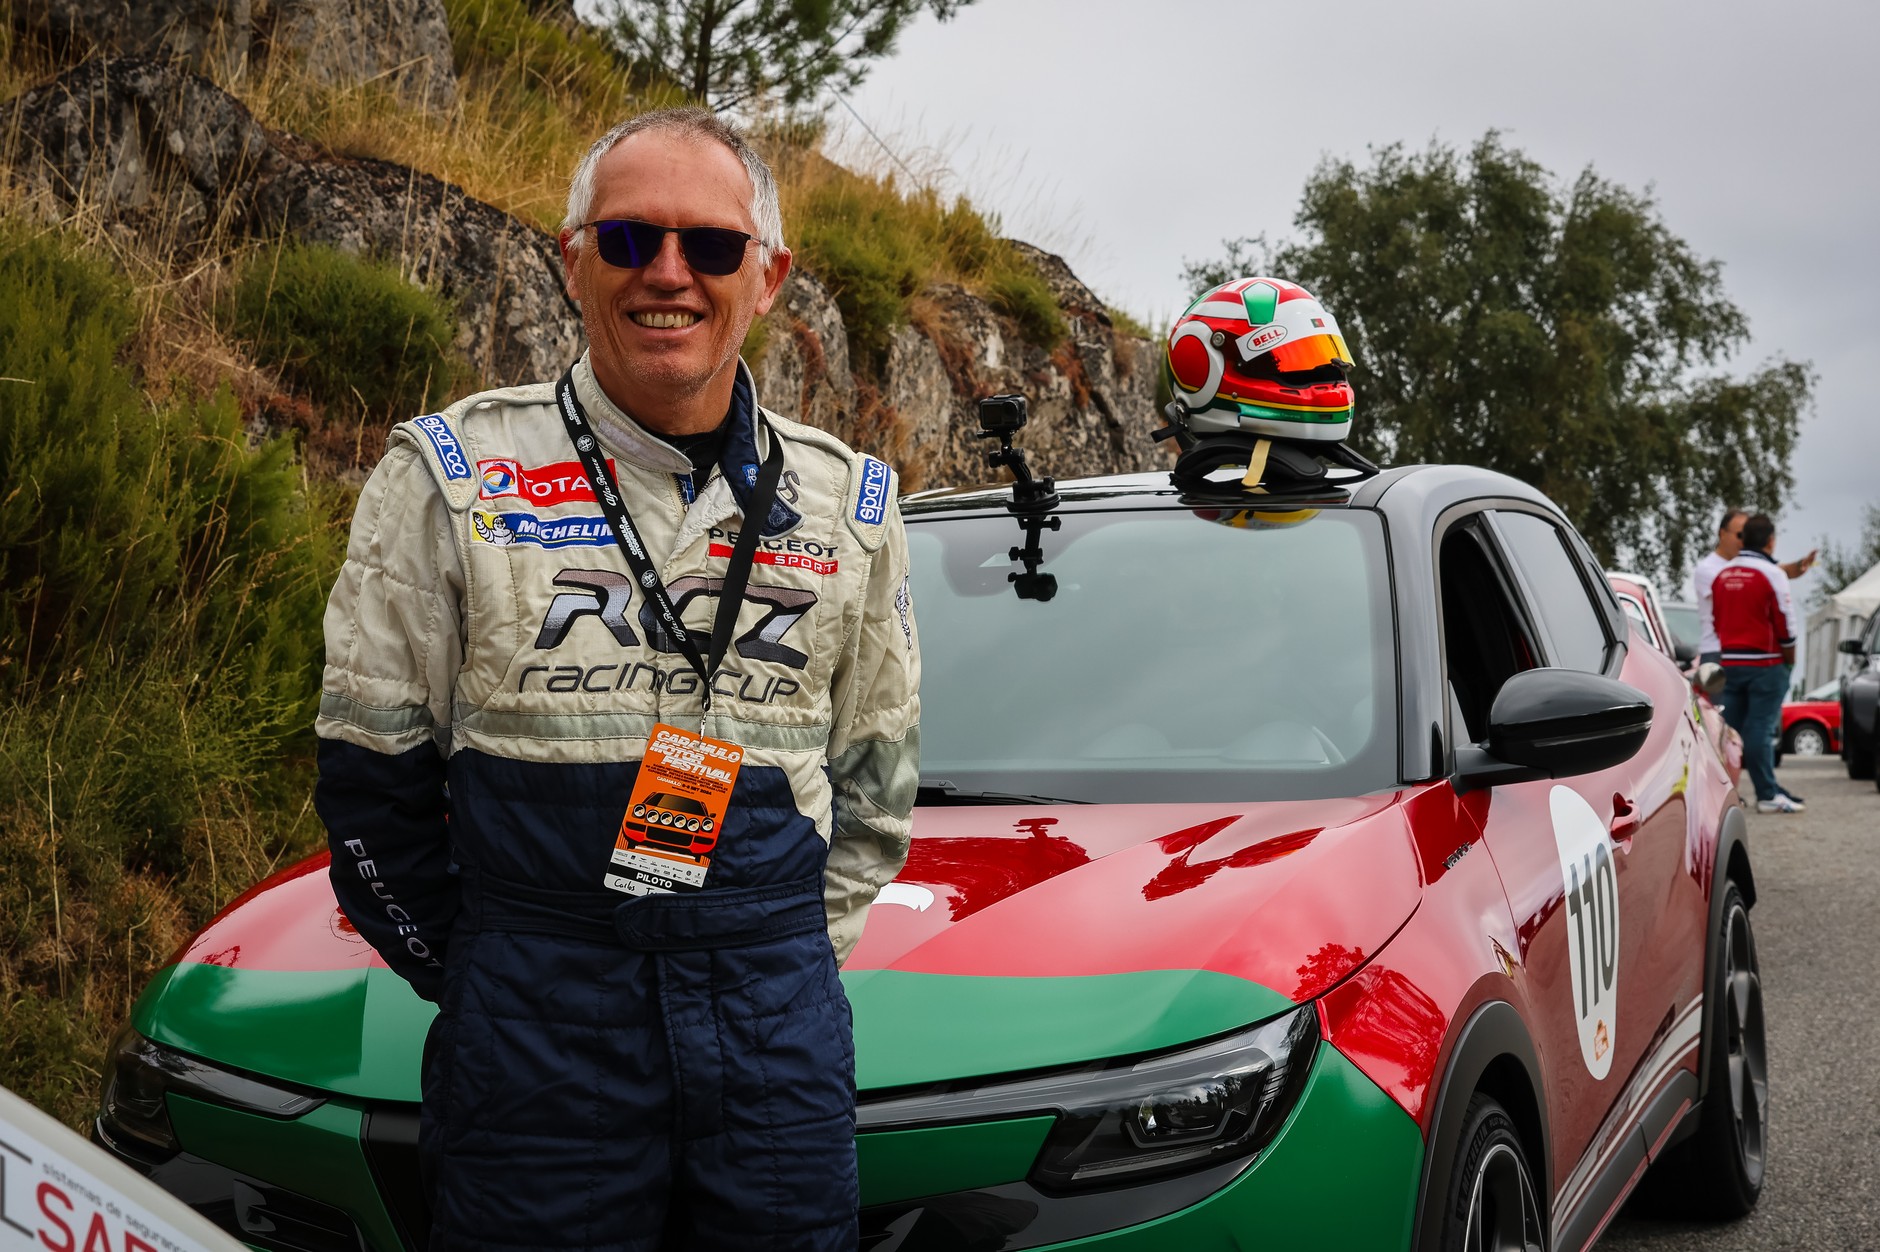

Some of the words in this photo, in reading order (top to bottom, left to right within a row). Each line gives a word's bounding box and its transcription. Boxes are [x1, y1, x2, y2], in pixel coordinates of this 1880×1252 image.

[1253, 329, 1282, 347] BELL
[423, 417, 467, 476] sparco
[519, 472, 593, 497] TOTA
[860, 461, 883, 520] sparco
[516, 519, 615, 539] MICHELIN
[709, 528, 839, 558] PEGEOT
[775, 555, 835, 573] SPORT
[649, 741, 705, 765] MOTOR
[656, 731, 740, 763] CARAMULO
[661, 756, 732, 784] FESTIVAL
[614, 878, 636, 892] Carlos
[636, 872, 673, 888] PILOTO
[1567, 842, 1616, 1020] 110
[42, 1162, 103, 1209] sistemas
[105, 1200, 122, 1218] de
